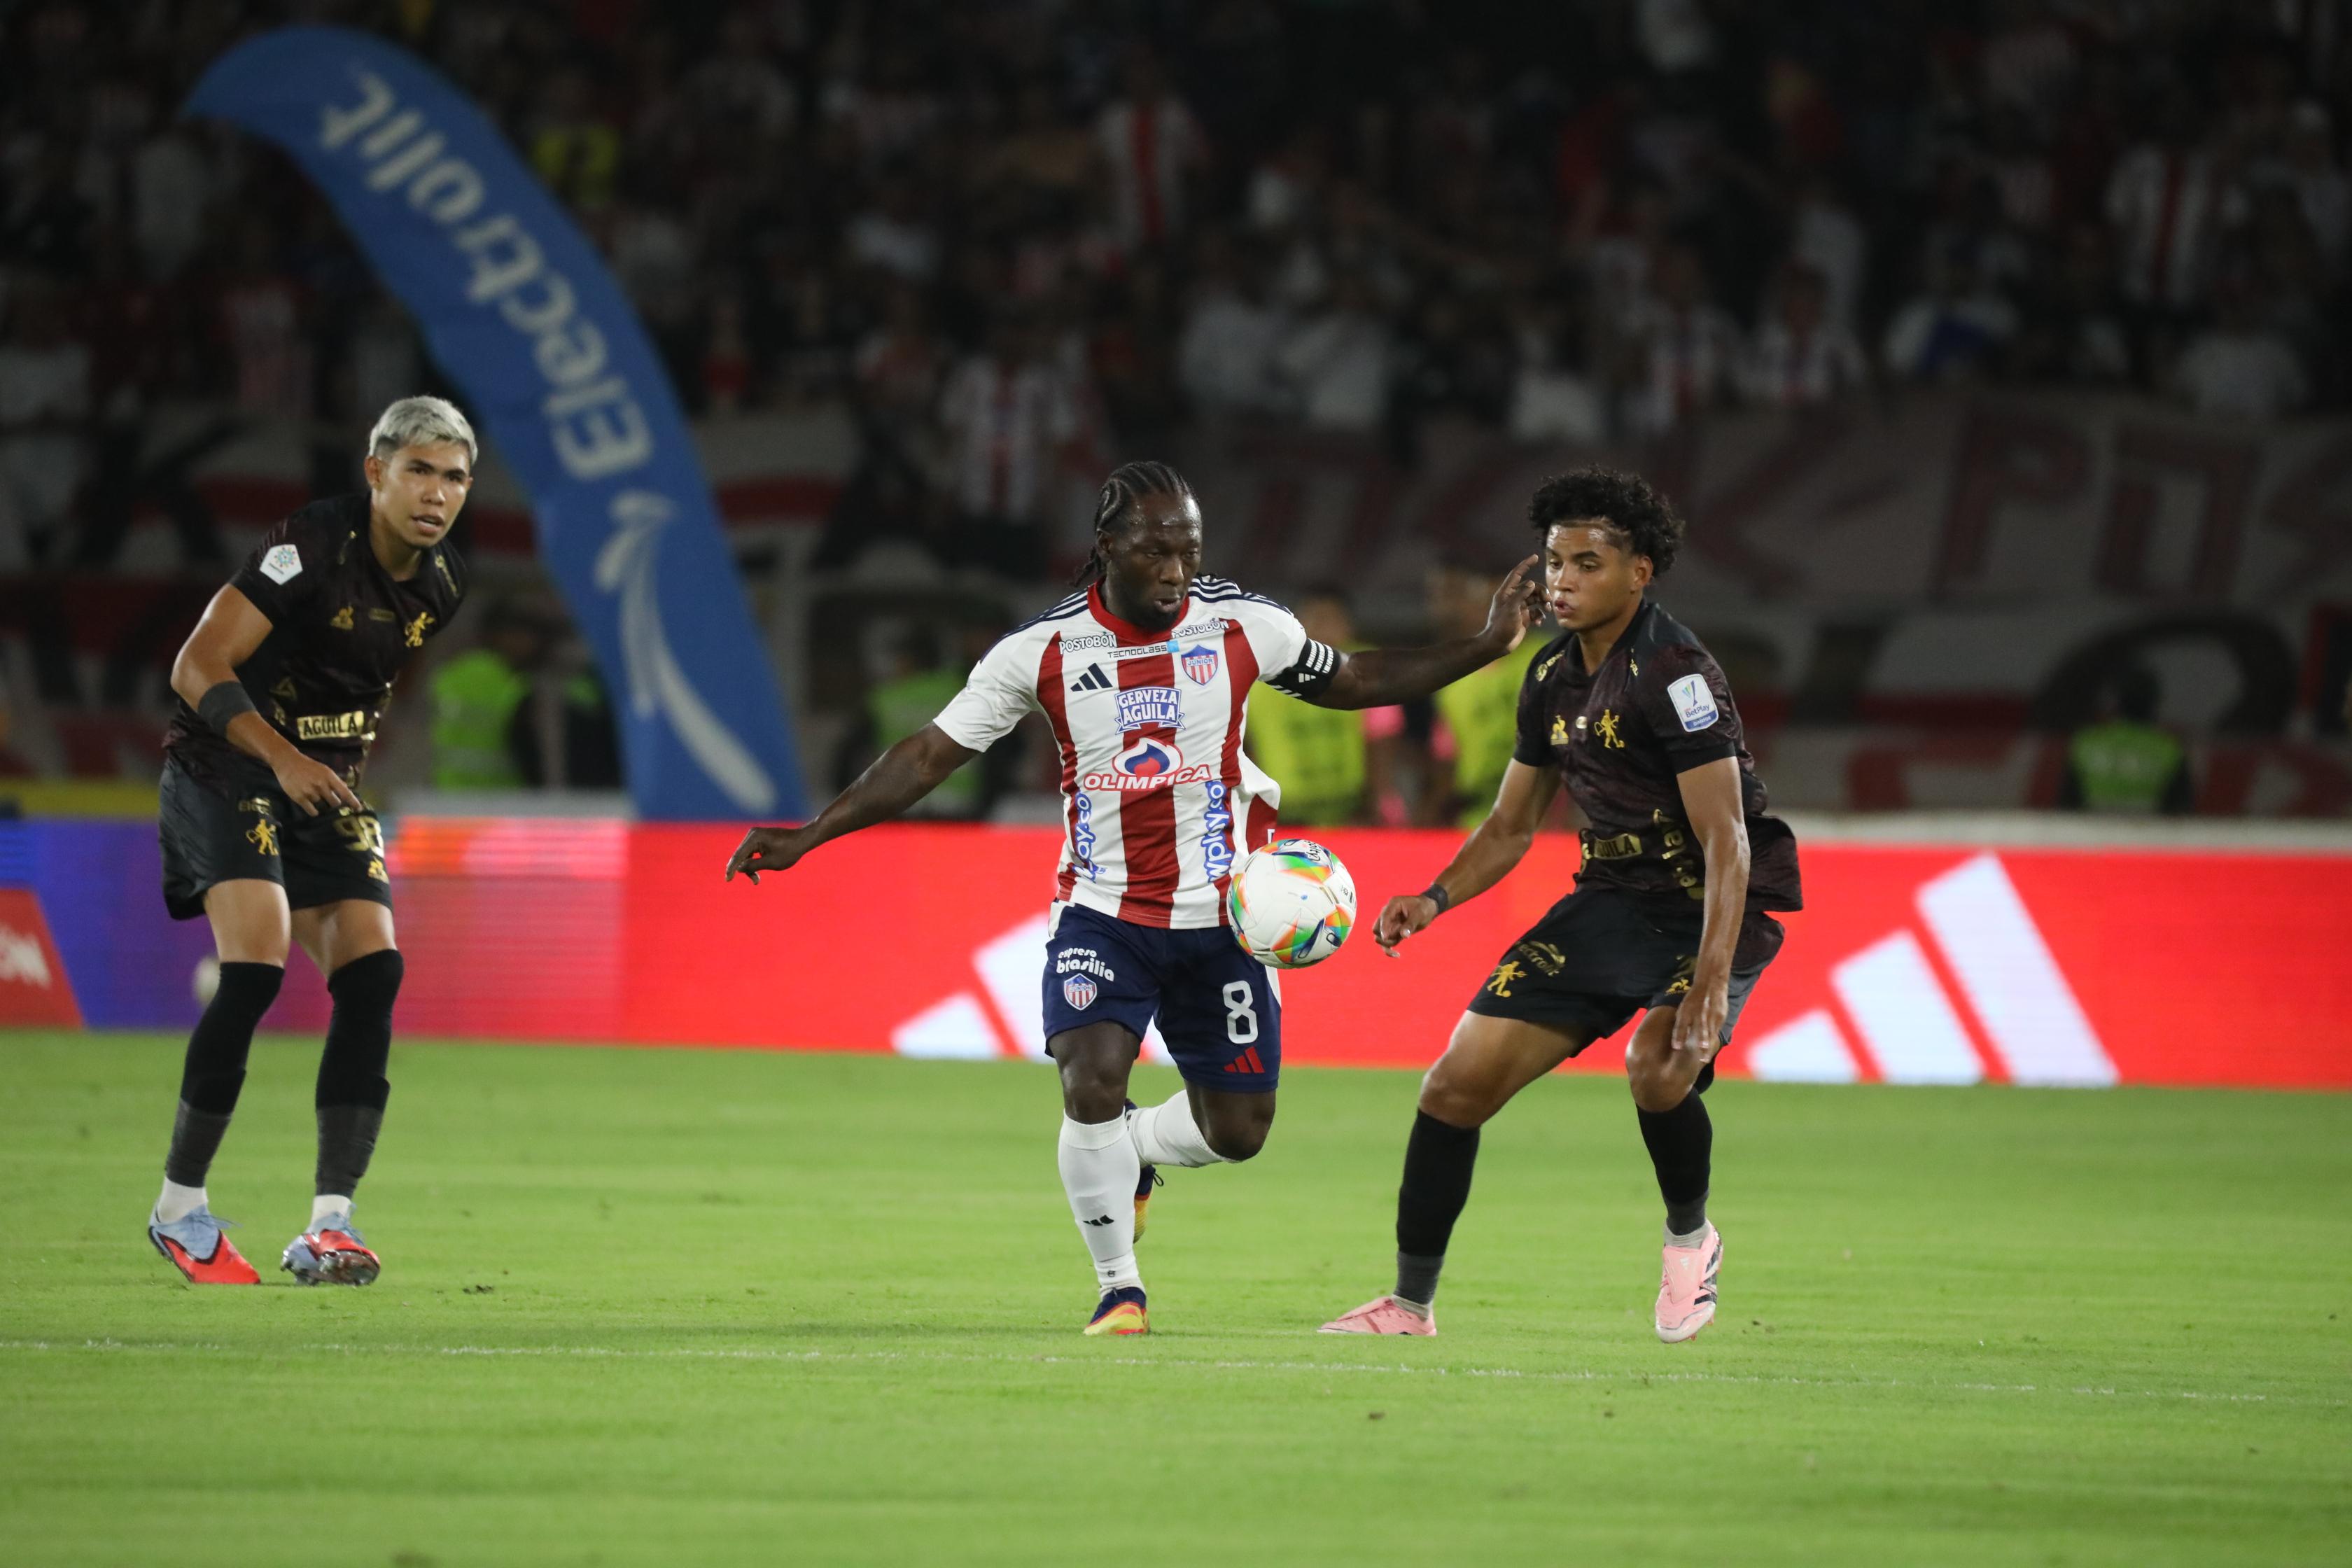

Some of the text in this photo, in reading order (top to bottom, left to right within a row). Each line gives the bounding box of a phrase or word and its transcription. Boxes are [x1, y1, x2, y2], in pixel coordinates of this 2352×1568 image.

[318, 67, 654, 479] Electrolit
[1058, 631, 1118, 654] POSTOBÓN
[1187, 658, 1214, 666] JUNIOR
[1119, 690, 1177, 708] CERVEZA
[1123, 704, 1176, 724] AGUILA
[1685, 704, 1709, 718] BetPlay
[303, 716, 358, 736] AGUILA
[1084, 764, 1212, 792] OLIMPICA
[1058, 947, 1097, 959] expreso
[1056, 958, 1114, 981] brasilia
[1222, 980, 1259, 1044] 8
